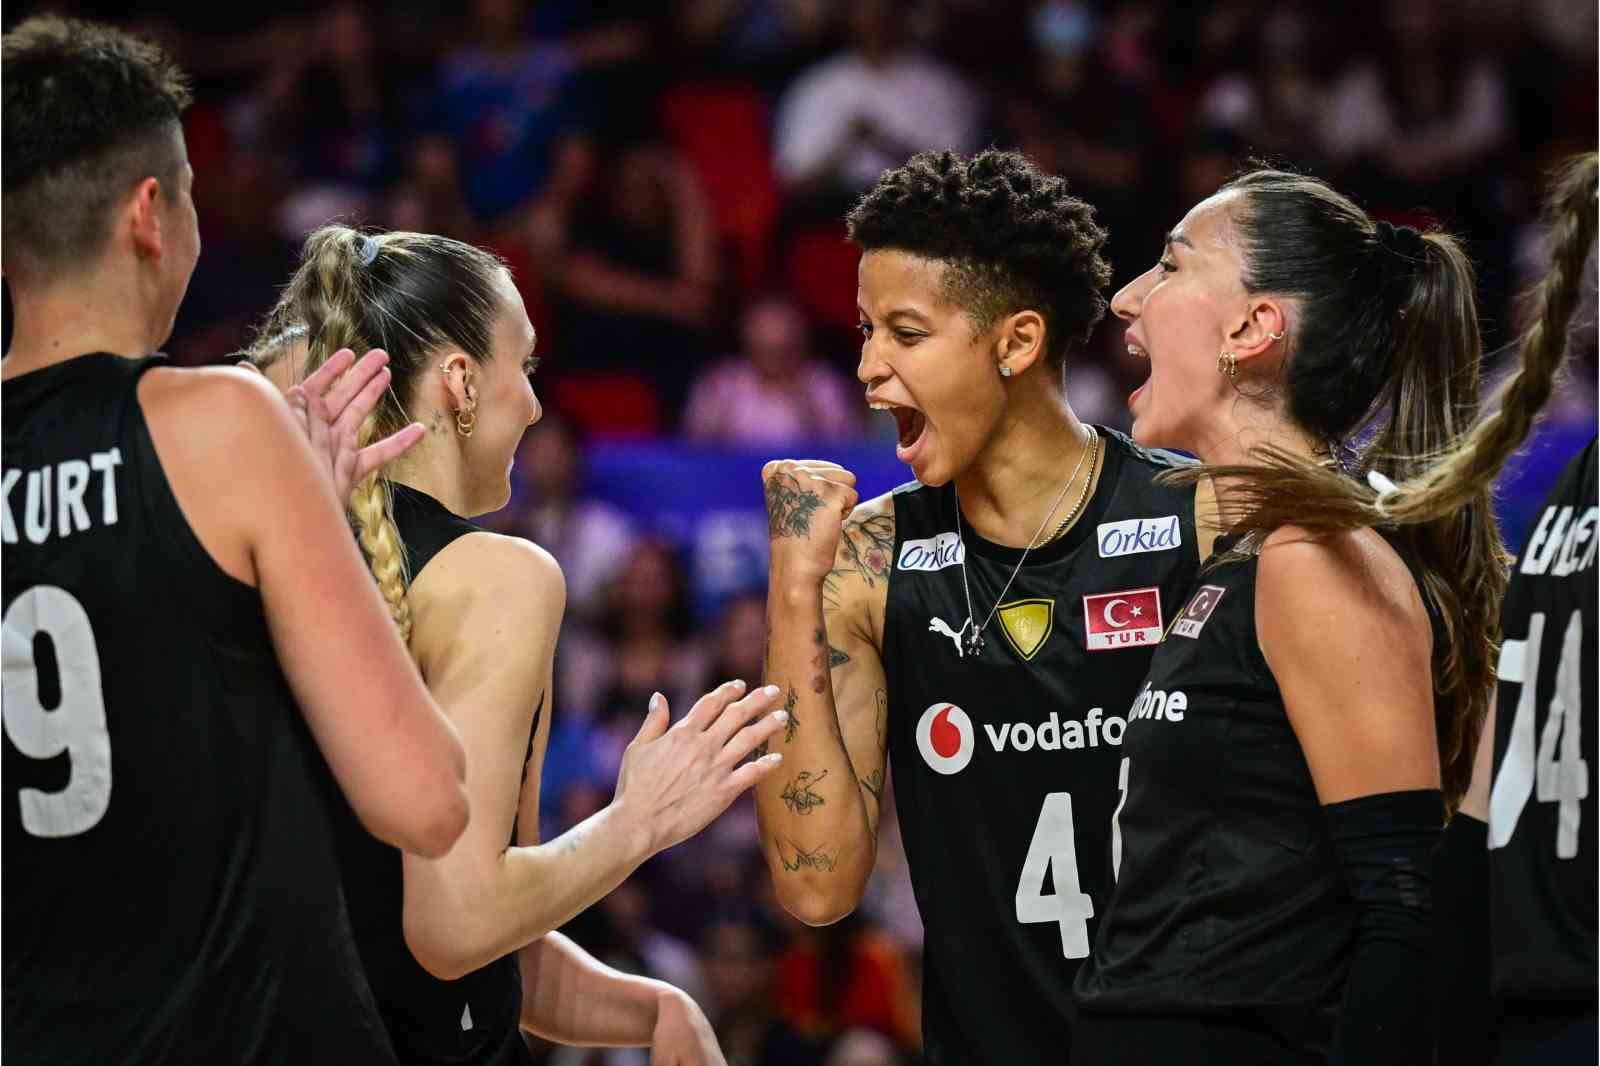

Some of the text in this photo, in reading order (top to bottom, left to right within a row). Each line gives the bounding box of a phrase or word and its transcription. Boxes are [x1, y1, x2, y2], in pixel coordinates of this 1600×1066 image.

[1101, 517, 1177, 555] Orkid
[1105, 631, 1146, 644] TUR
[1, 585, 112, 838] 9
[1015, 792, 1095, 960] 4
